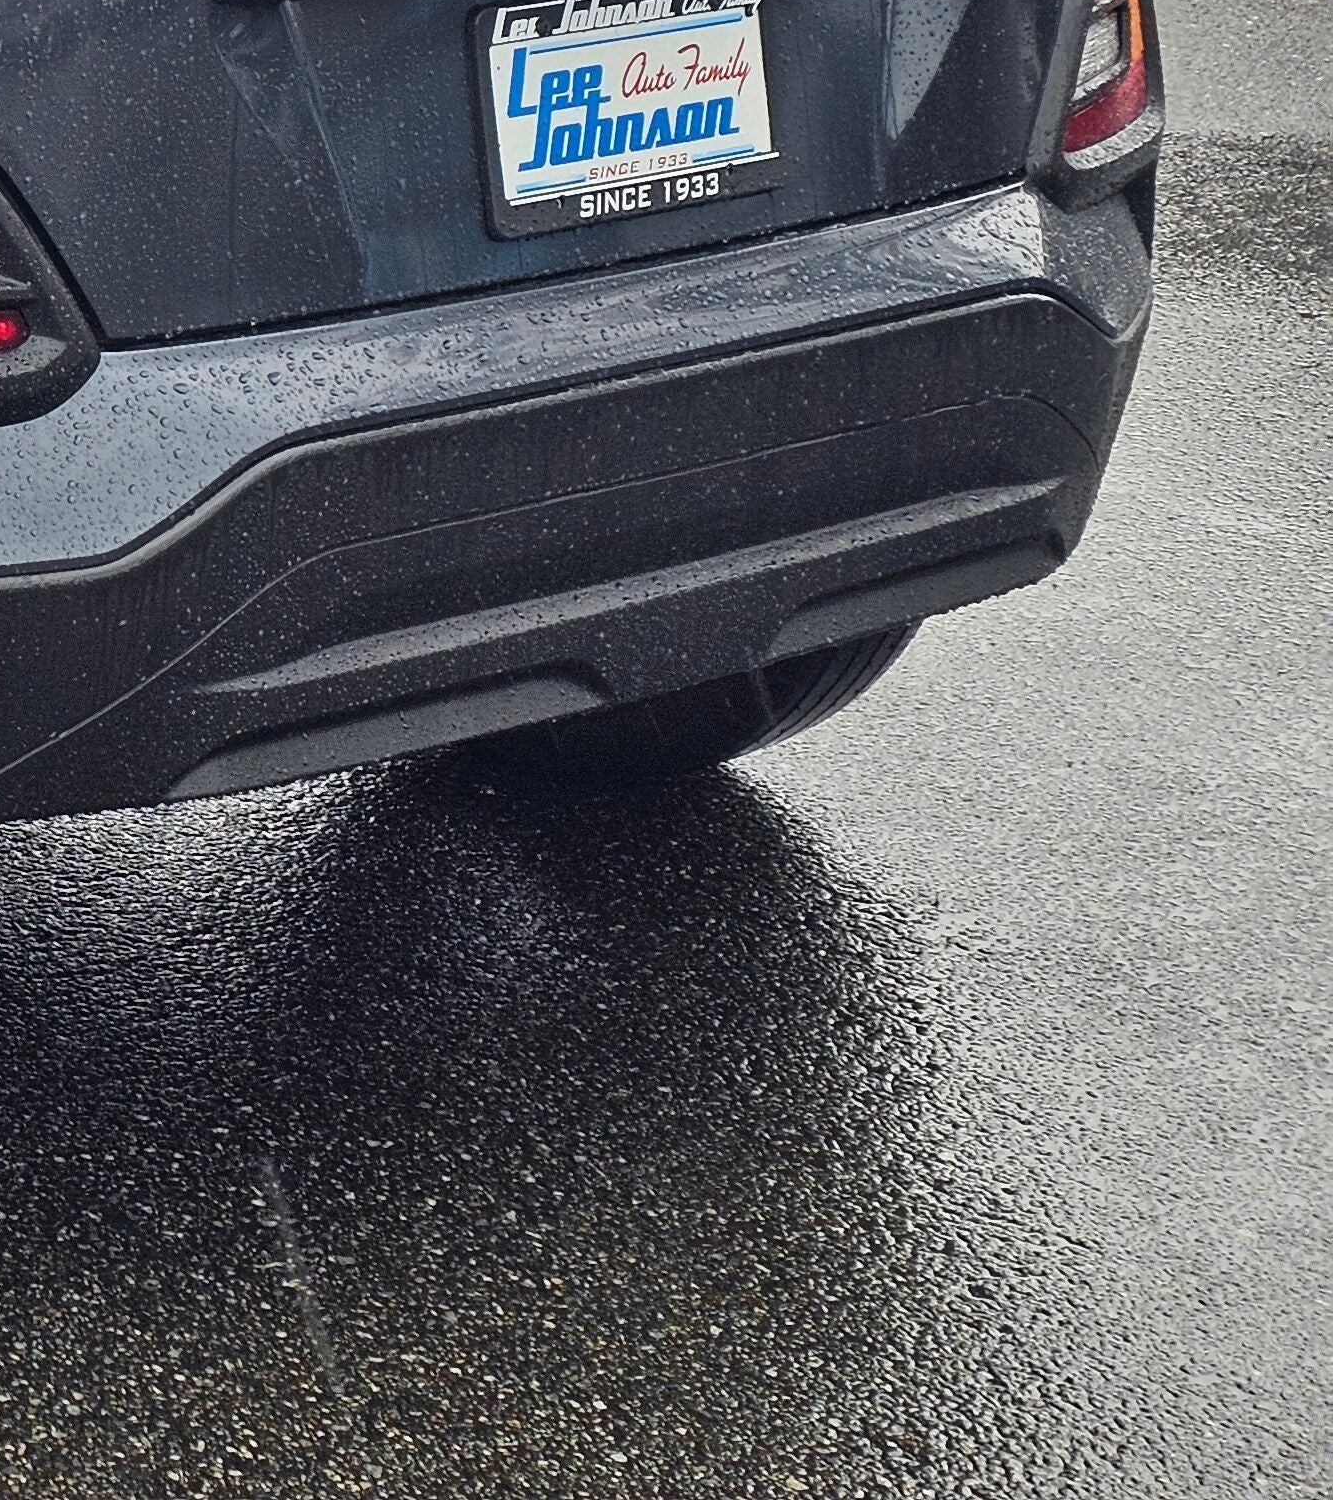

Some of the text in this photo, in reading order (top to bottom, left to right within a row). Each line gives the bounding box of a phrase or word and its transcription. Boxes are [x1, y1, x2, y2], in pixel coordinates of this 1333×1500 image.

[507, 46, 611, 119] Lee
[622, 37, 751, 99] Auto Family
[518, 96, 740, 172] Johnson
[579, 172, 720, 218] SINCE 1933
[588, 153, 689, 180] SINCE 1933
